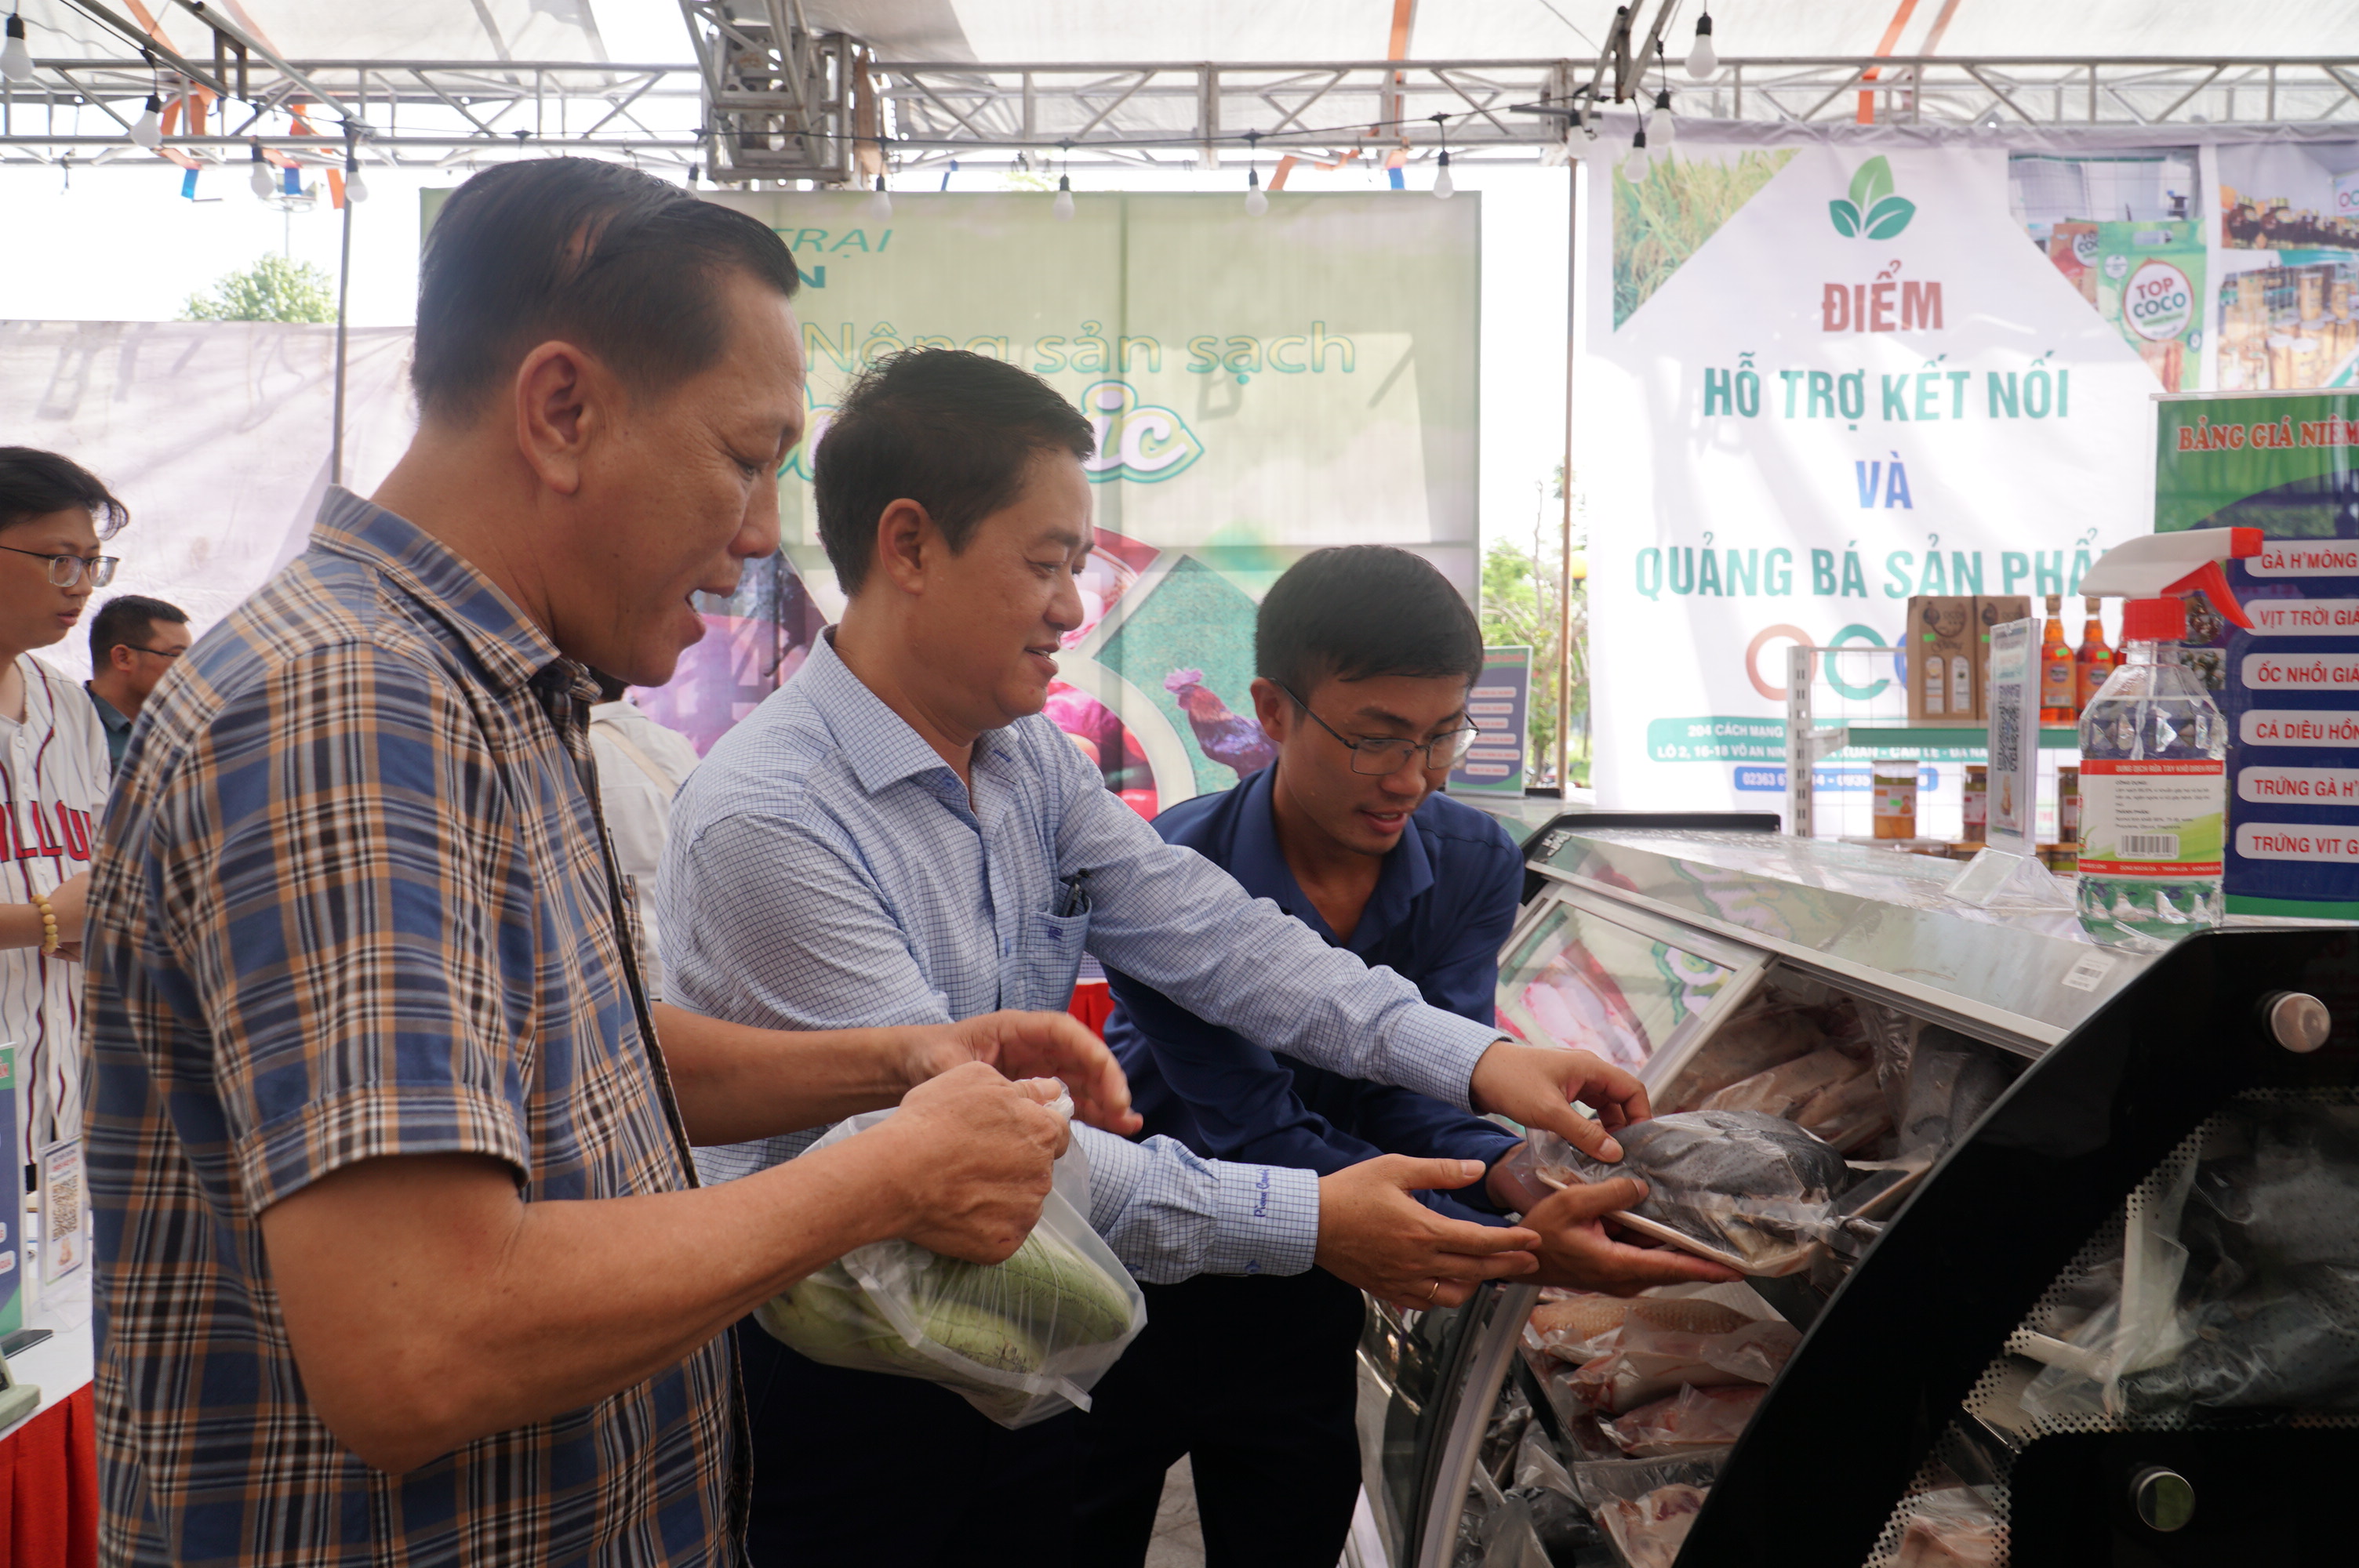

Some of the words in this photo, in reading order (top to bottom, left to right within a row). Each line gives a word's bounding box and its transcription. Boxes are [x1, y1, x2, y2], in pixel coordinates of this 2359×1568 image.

[1822, 260, 1944, 333] ĐIỂM
[2136, 277, 2174, 299] TOP
[2132, 292, 2186, 318] COCO
[1033, 320, 1161, 373] sản
[1185, 321, 1355, 385] sạch
[1704, 350, 1760, 418] HỖ
[1779, 367, 1866, 430] TRỢ
[1881, 354, 1971, 422] KẾT
[1986, 350, 2070, 419] NỐI
[2177, 414, 2246, 452] BẢNG
[2249, 414, 2295, 449] GIÁ
[1855, 452, 1914, 510] VÀ
[1635, 532, 1793, 601] QUẢNG
[1811, 539, 1868, 597] BÁ
[1885, 534, 1983, 599] SẢN
[2001, 528, 2113, 599] PHẨ
[2262, 550, 2285, 569] GÀ
[2259, 610, 2285, 629] VỊT
[2290, 606, 2329, 626] TRỜI
[2258, 660, 2282, 682] ỐC
[2287, 660, 2328, 683] NHỒI
[1714, 721, 1747, 735] CÁCH
[1766, 746, 1787, 757] NIN
[2254, 775, 2310, 796] TRỨNG
[2314, 777, 2338, 797] GÀ
[2252, 833, 2310, 853] TRỨNG
